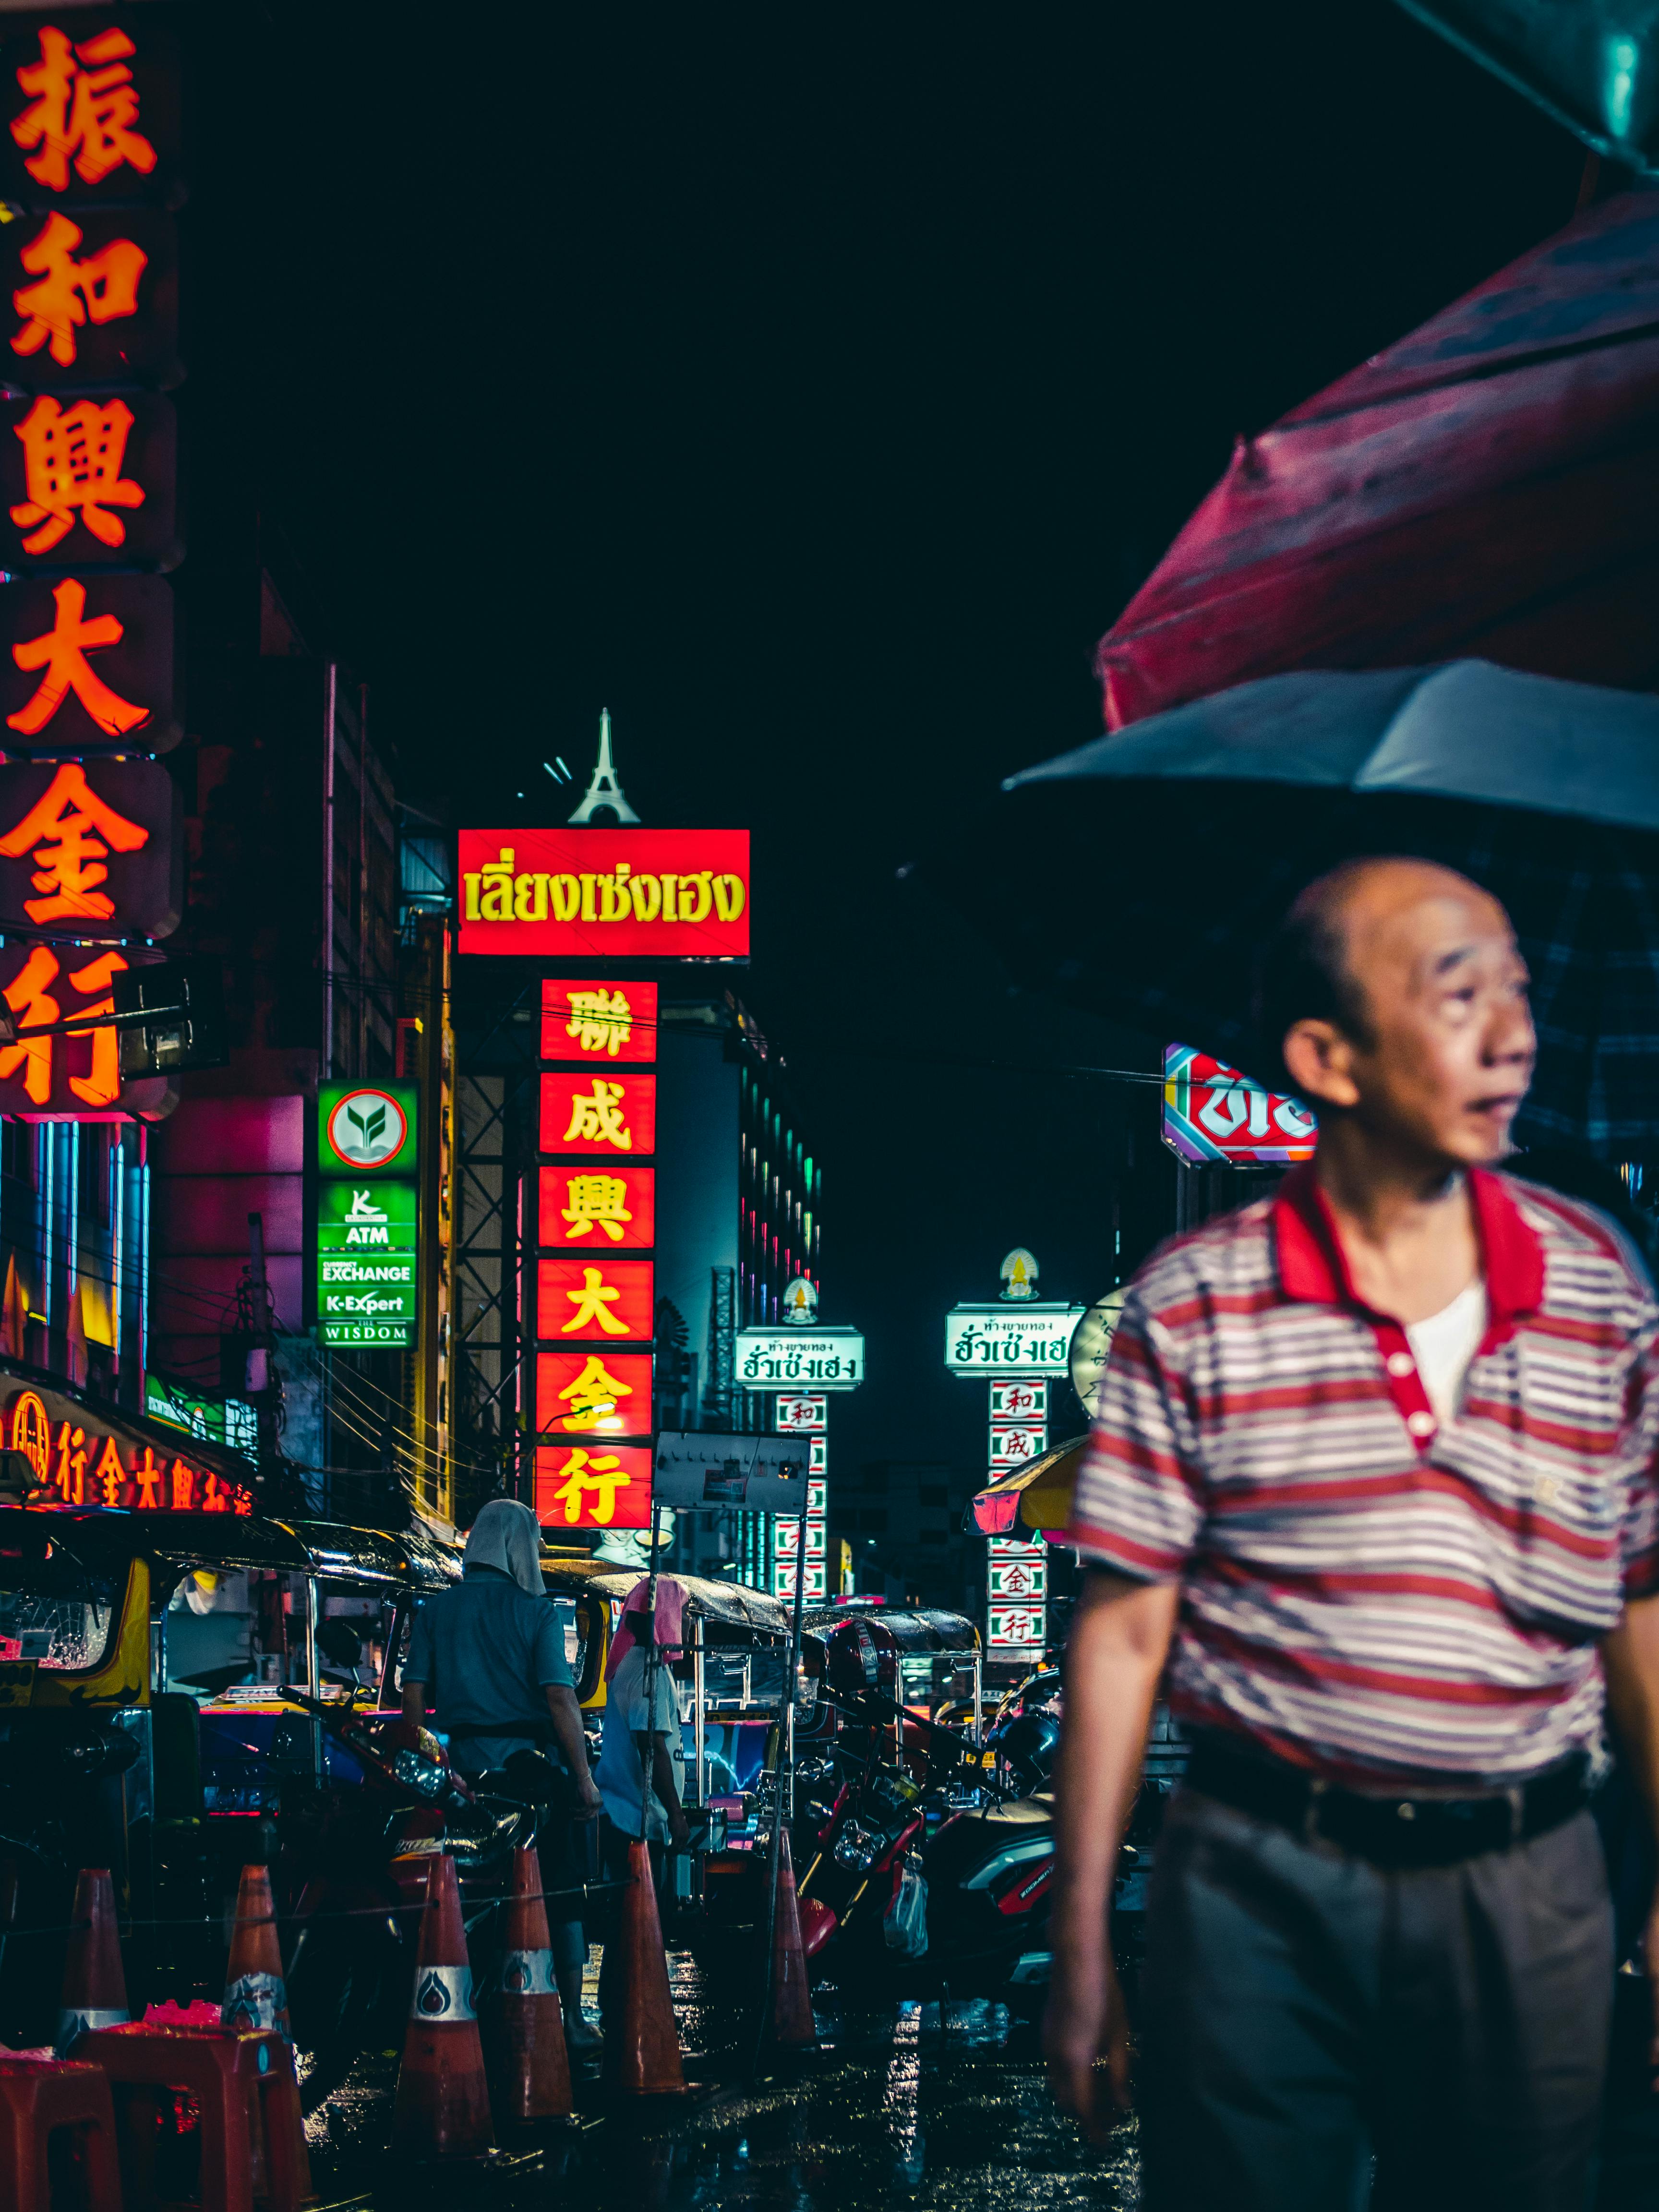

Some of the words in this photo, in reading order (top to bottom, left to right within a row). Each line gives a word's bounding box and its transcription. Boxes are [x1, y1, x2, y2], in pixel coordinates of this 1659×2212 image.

[0, 26, 157, 1107] 振和興大金行
[346, 1227, 389, 1244] ATM
[554, 988, 633, 1524] 聯成興大金行
[323, 1267, 410, 1281] EXCHANGE
[326, 1290, 403, 1315] K-Expert
[325, 1327, 406, 1339] WISDOM
[984, 1318, 1053, 1331] ห้างขายทอง
[955, 1324, 1067, 1362] ฮั่วเซ่งเฮ
[1003, 1388, 1032, 1640] 和成金行
